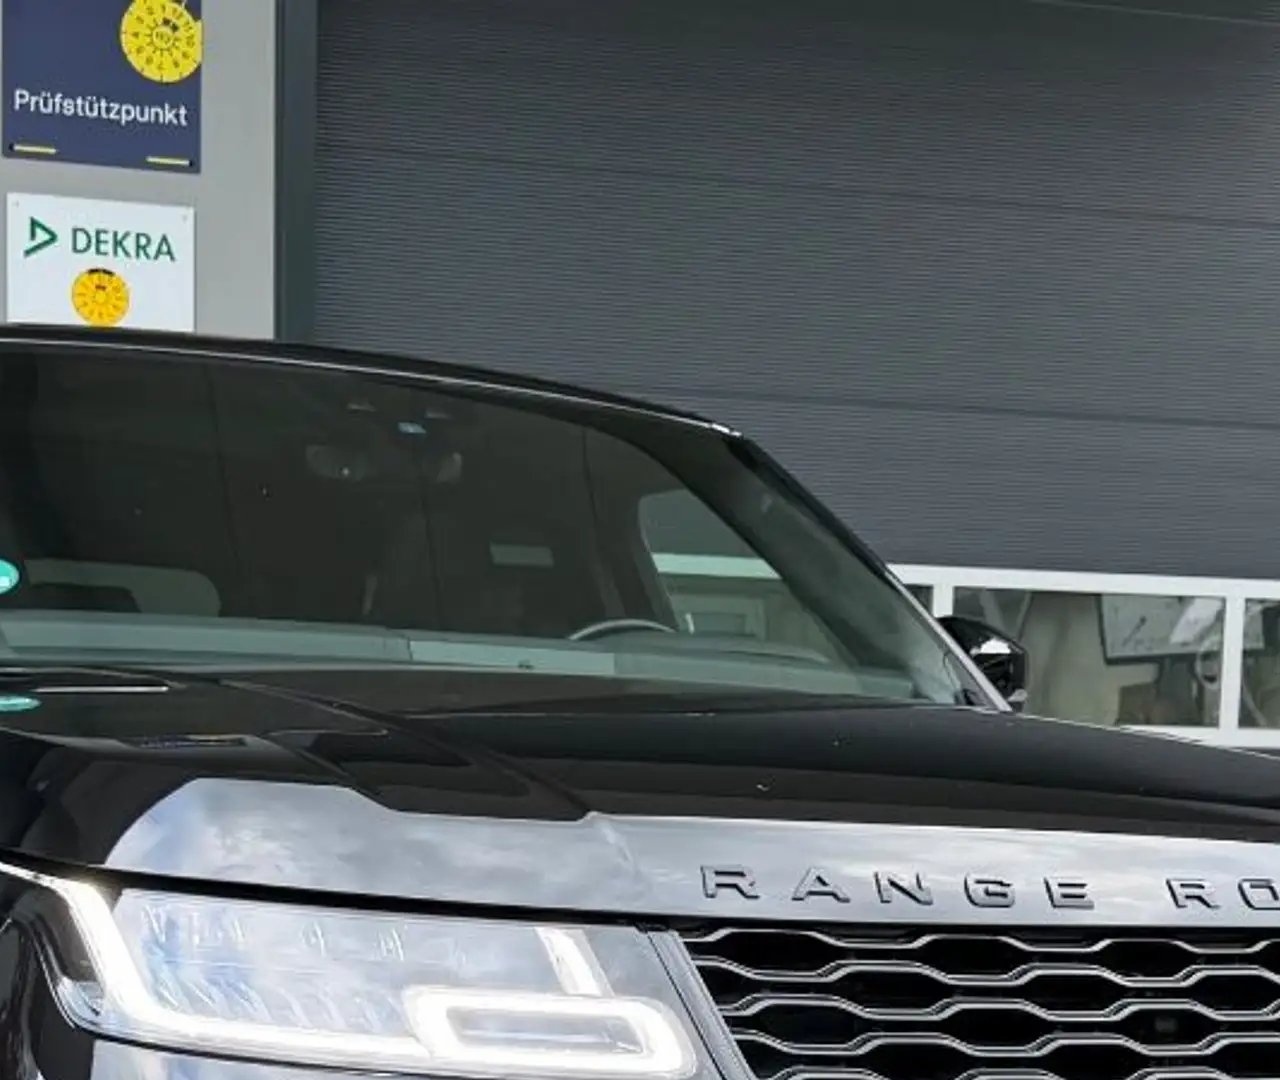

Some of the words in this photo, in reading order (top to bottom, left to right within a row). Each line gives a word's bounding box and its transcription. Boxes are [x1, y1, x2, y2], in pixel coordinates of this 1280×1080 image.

[13, 89, 188, 126] Prüfstützpunkt
[71, 226, 176, 263] DEKRA
[699, 864, 1095, 911] RANGE
